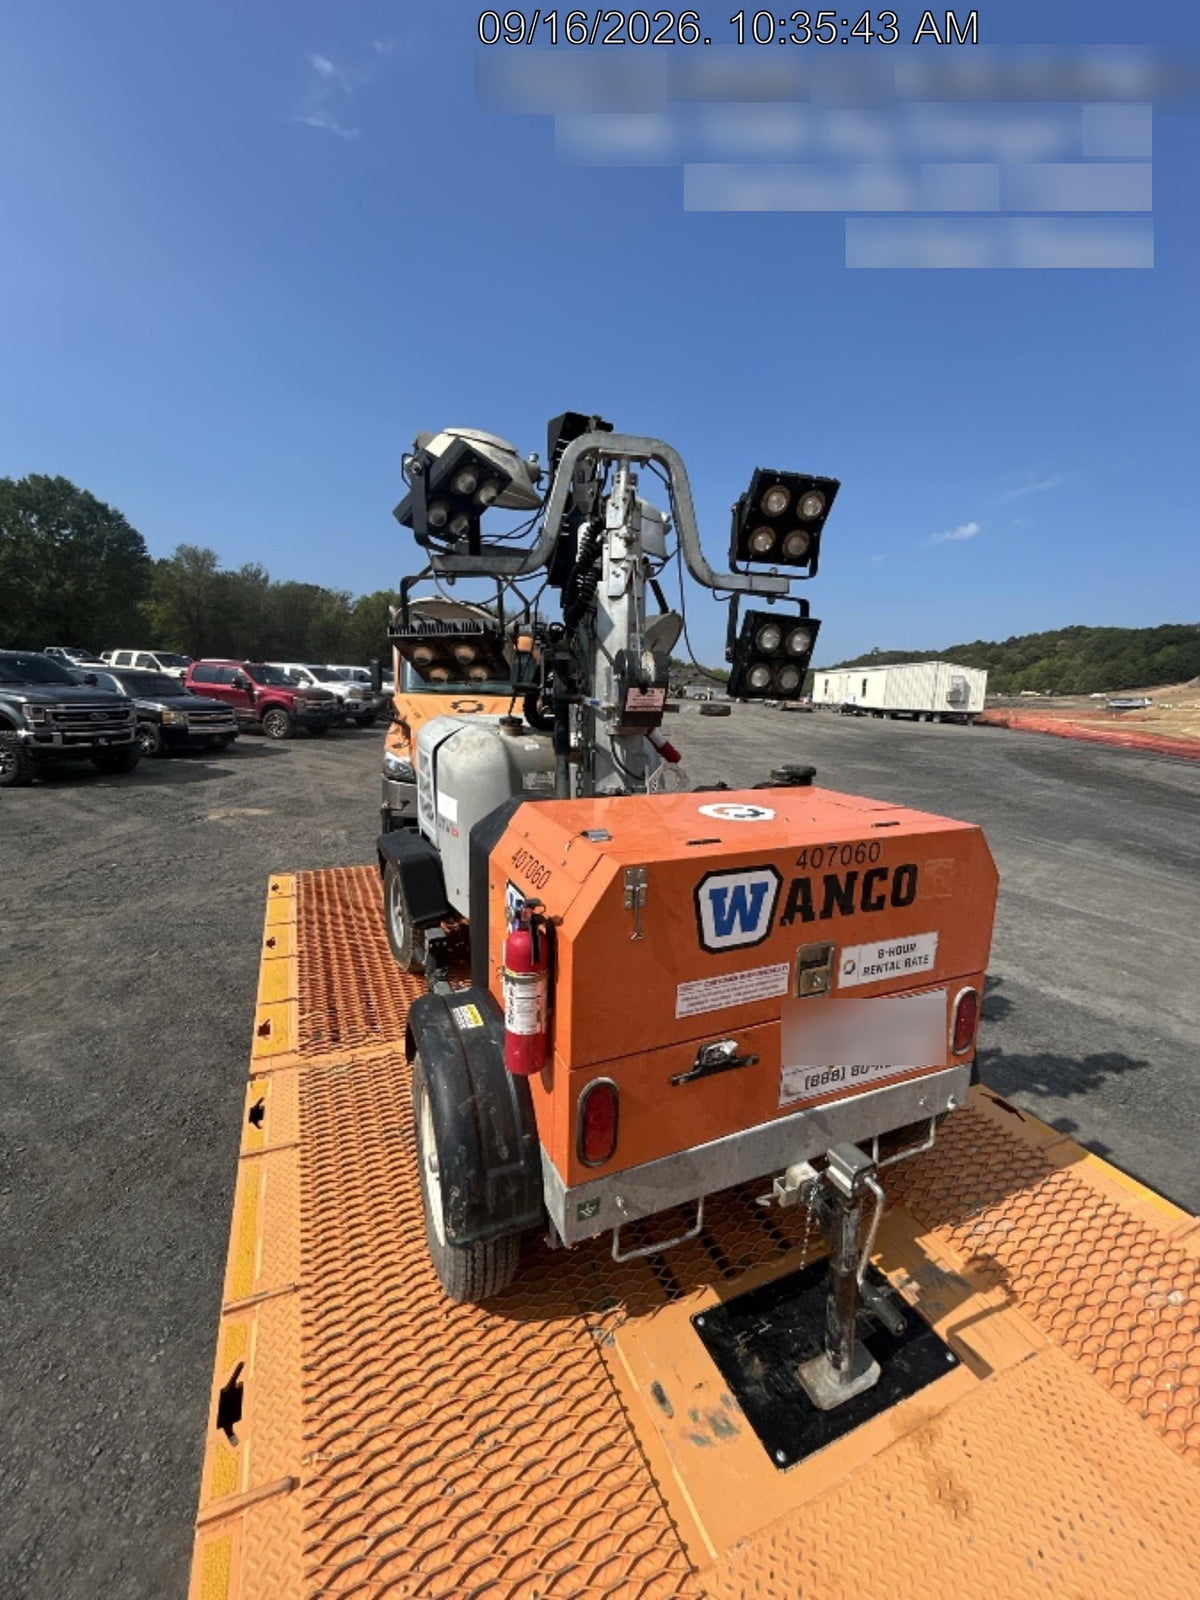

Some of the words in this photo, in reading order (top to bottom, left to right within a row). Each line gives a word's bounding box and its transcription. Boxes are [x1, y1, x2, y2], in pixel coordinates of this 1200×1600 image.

[511, 847, 552, 890] 407060
[796, 841, 882, 870] 407060
[708, 863, 919, 938] WANCO
[862, 960, 901, 977] RENTAL
[904, 954, 930, 969] RATE
[804, 1065, 846, 1091] (888)
